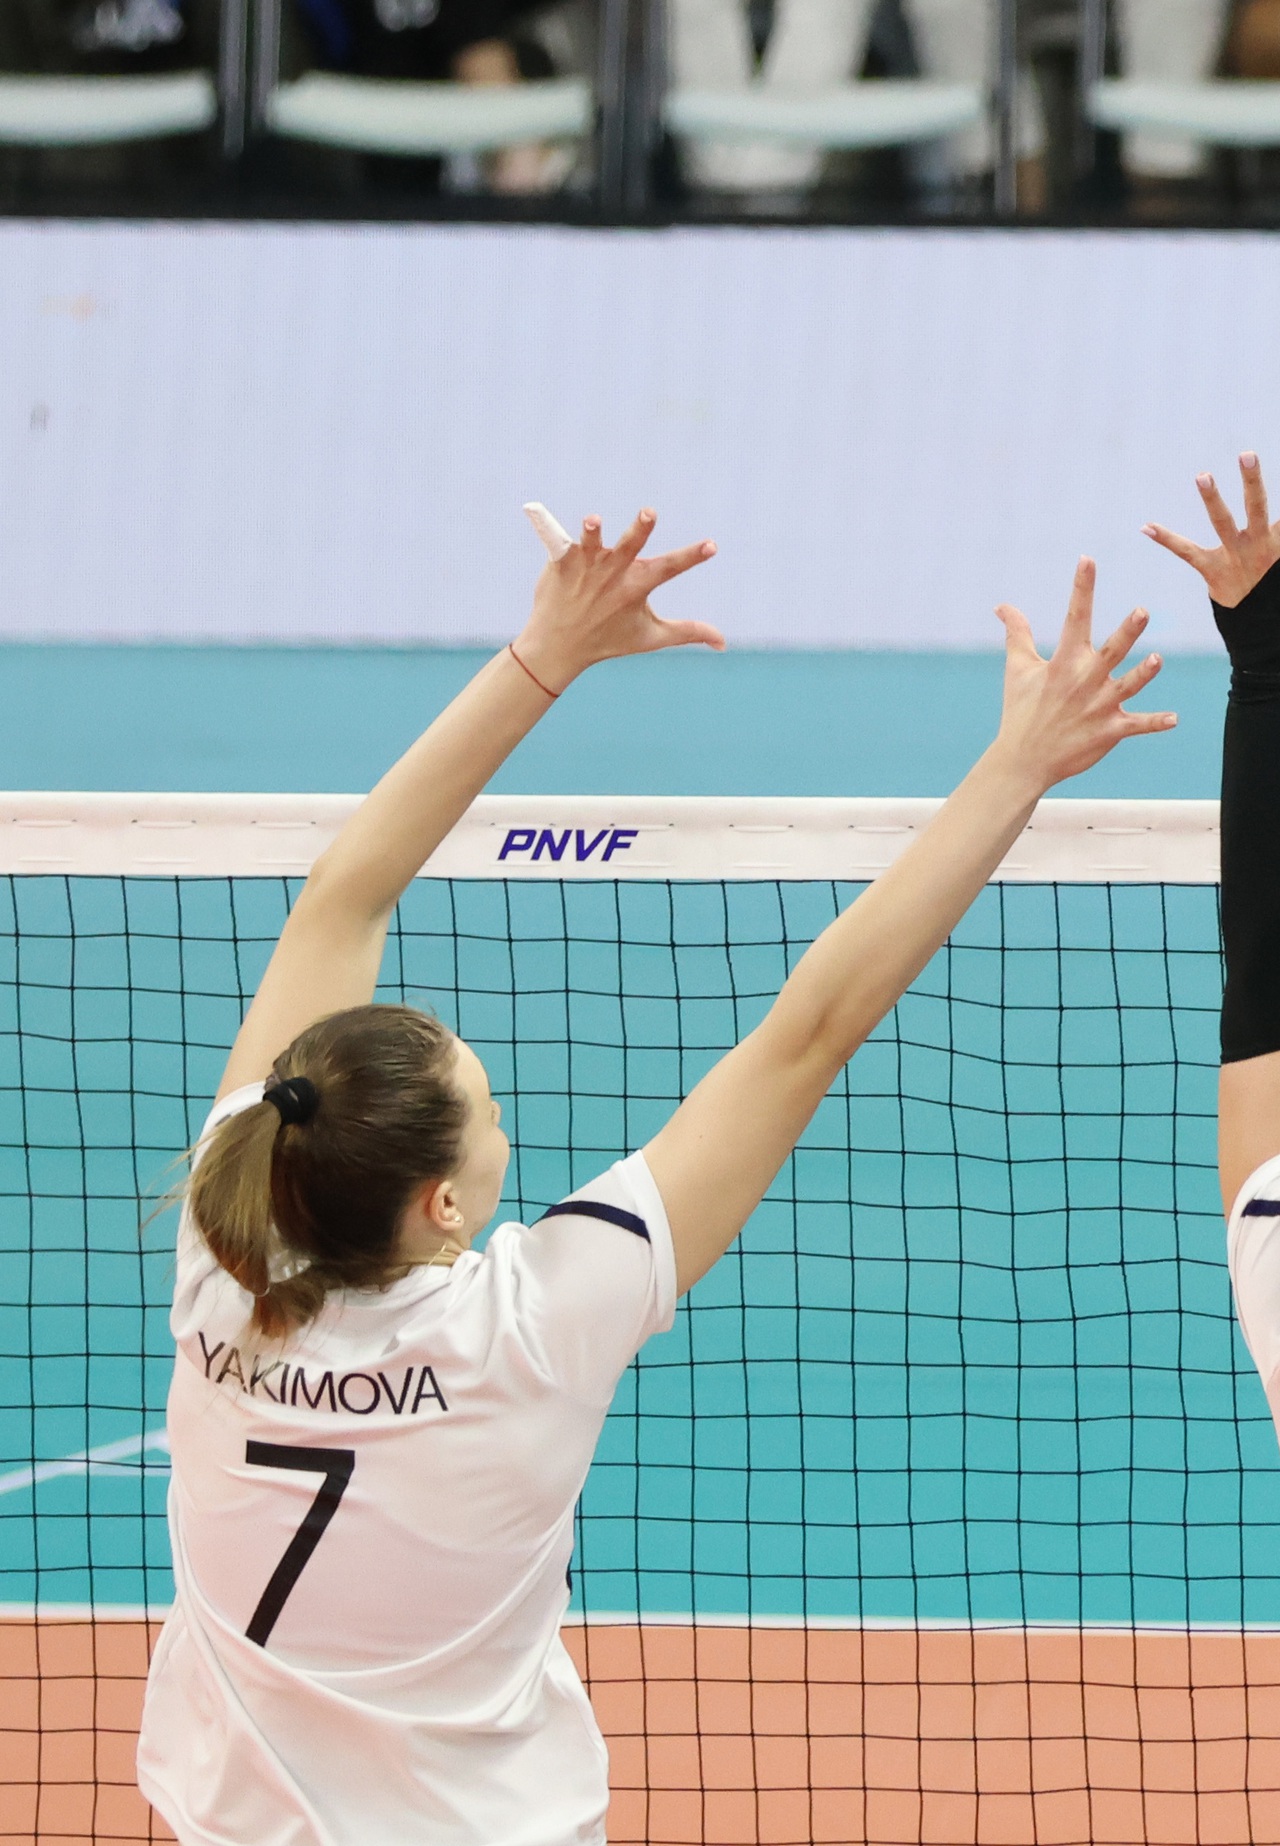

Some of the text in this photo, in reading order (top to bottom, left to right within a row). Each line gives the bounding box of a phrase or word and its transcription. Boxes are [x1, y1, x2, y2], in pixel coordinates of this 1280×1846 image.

[497, 829, 640, 862] PNVF
[198, 1331, 448, 1415] YAKIMOVA
[245, 1439, 355, 1649] 7
